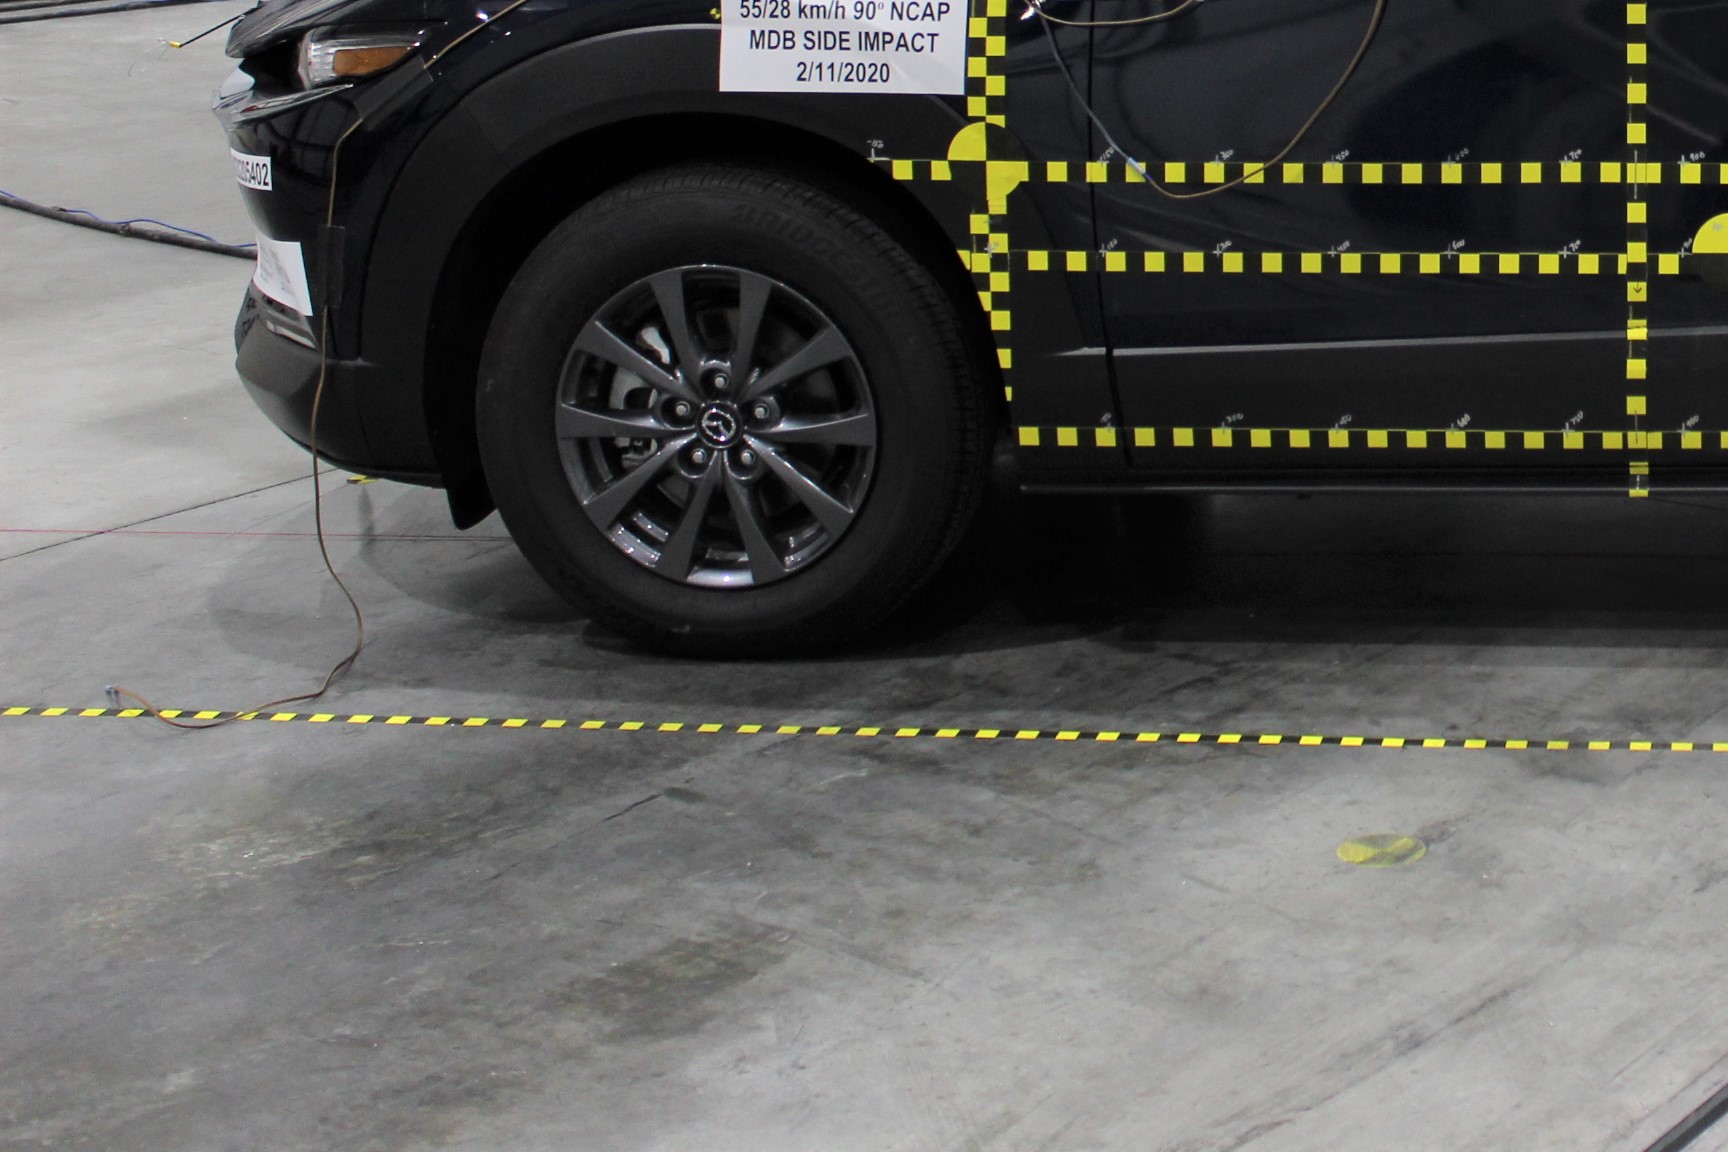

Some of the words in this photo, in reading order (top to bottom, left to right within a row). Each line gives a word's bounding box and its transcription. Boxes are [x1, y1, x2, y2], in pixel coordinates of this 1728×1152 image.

[740, 0, 791, 19] 55/28
[798, 0, 845, 19] km/h
[890, 2, 950, 21] NCAP
[750, 30, 796, 49] MDB
[803, 30, 850, 51] SIDE
[859, 31, 939, 52] IMPACT
[796, 61, 890, 83] 2/11/2020
